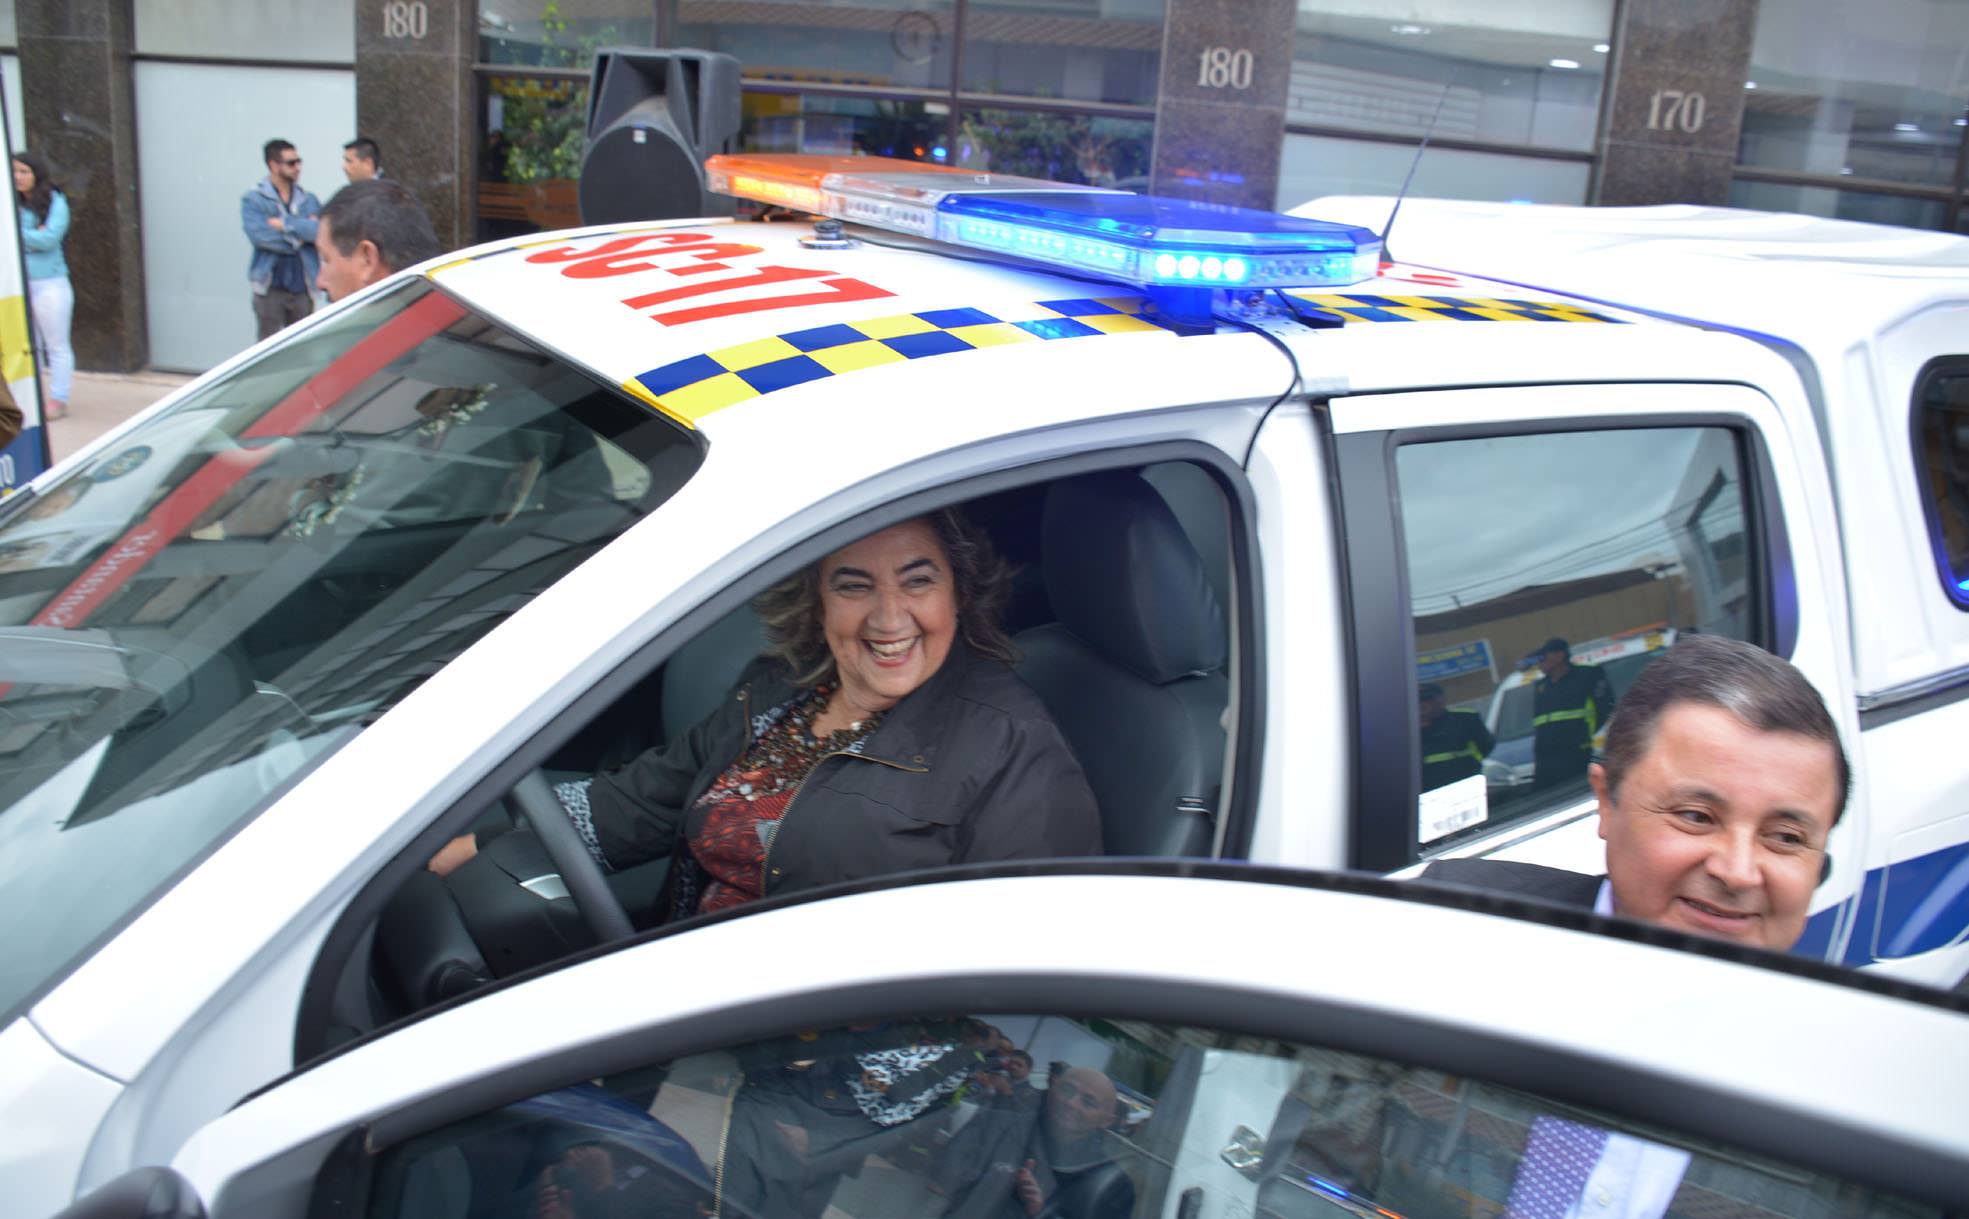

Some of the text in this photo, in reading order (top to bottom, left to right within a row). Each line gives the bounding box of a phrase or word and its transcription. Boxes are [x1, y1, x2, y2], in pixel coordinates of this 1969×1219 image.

[383, 1, 427, 39] 180
[1198, 46, 1253, 89] 180
[1647, 89, 1705, 133] 170
[525, 233, 899, 327] SC-17
